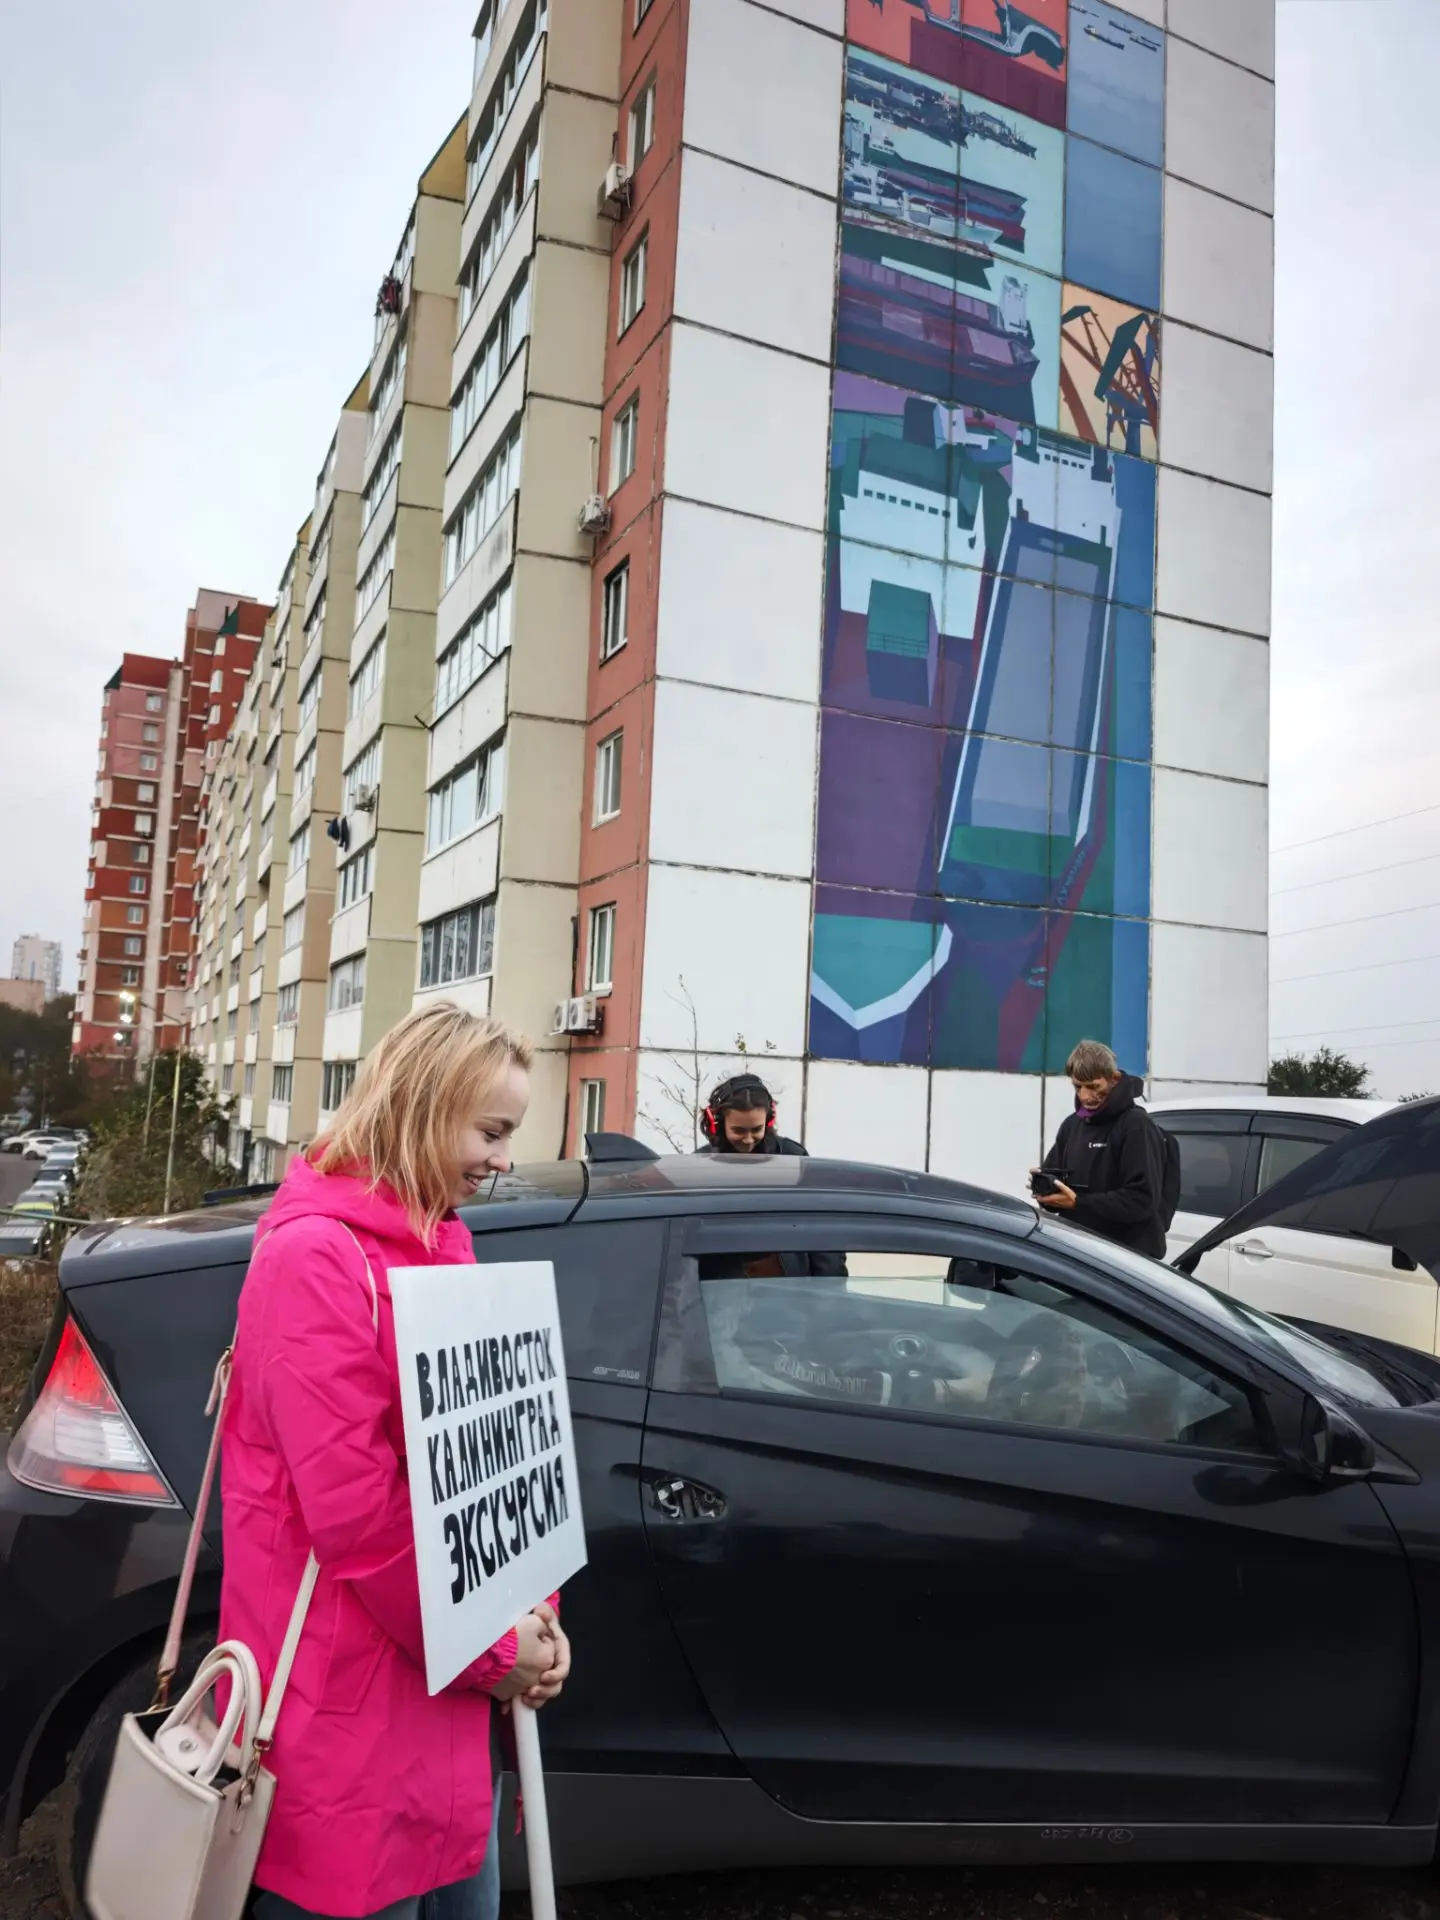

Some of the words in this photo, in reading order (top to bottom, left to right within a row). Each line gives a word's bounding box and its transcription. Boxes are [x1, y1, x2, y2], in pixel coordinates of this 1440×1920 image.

[415, 1327, 557, 1420] ВЛАДИВОСТОК
[427, 1390, 561, 1505] КАЛИНИНГРАД
[444, 1454, 569, 1605] ЭКСКУРСИЯ
